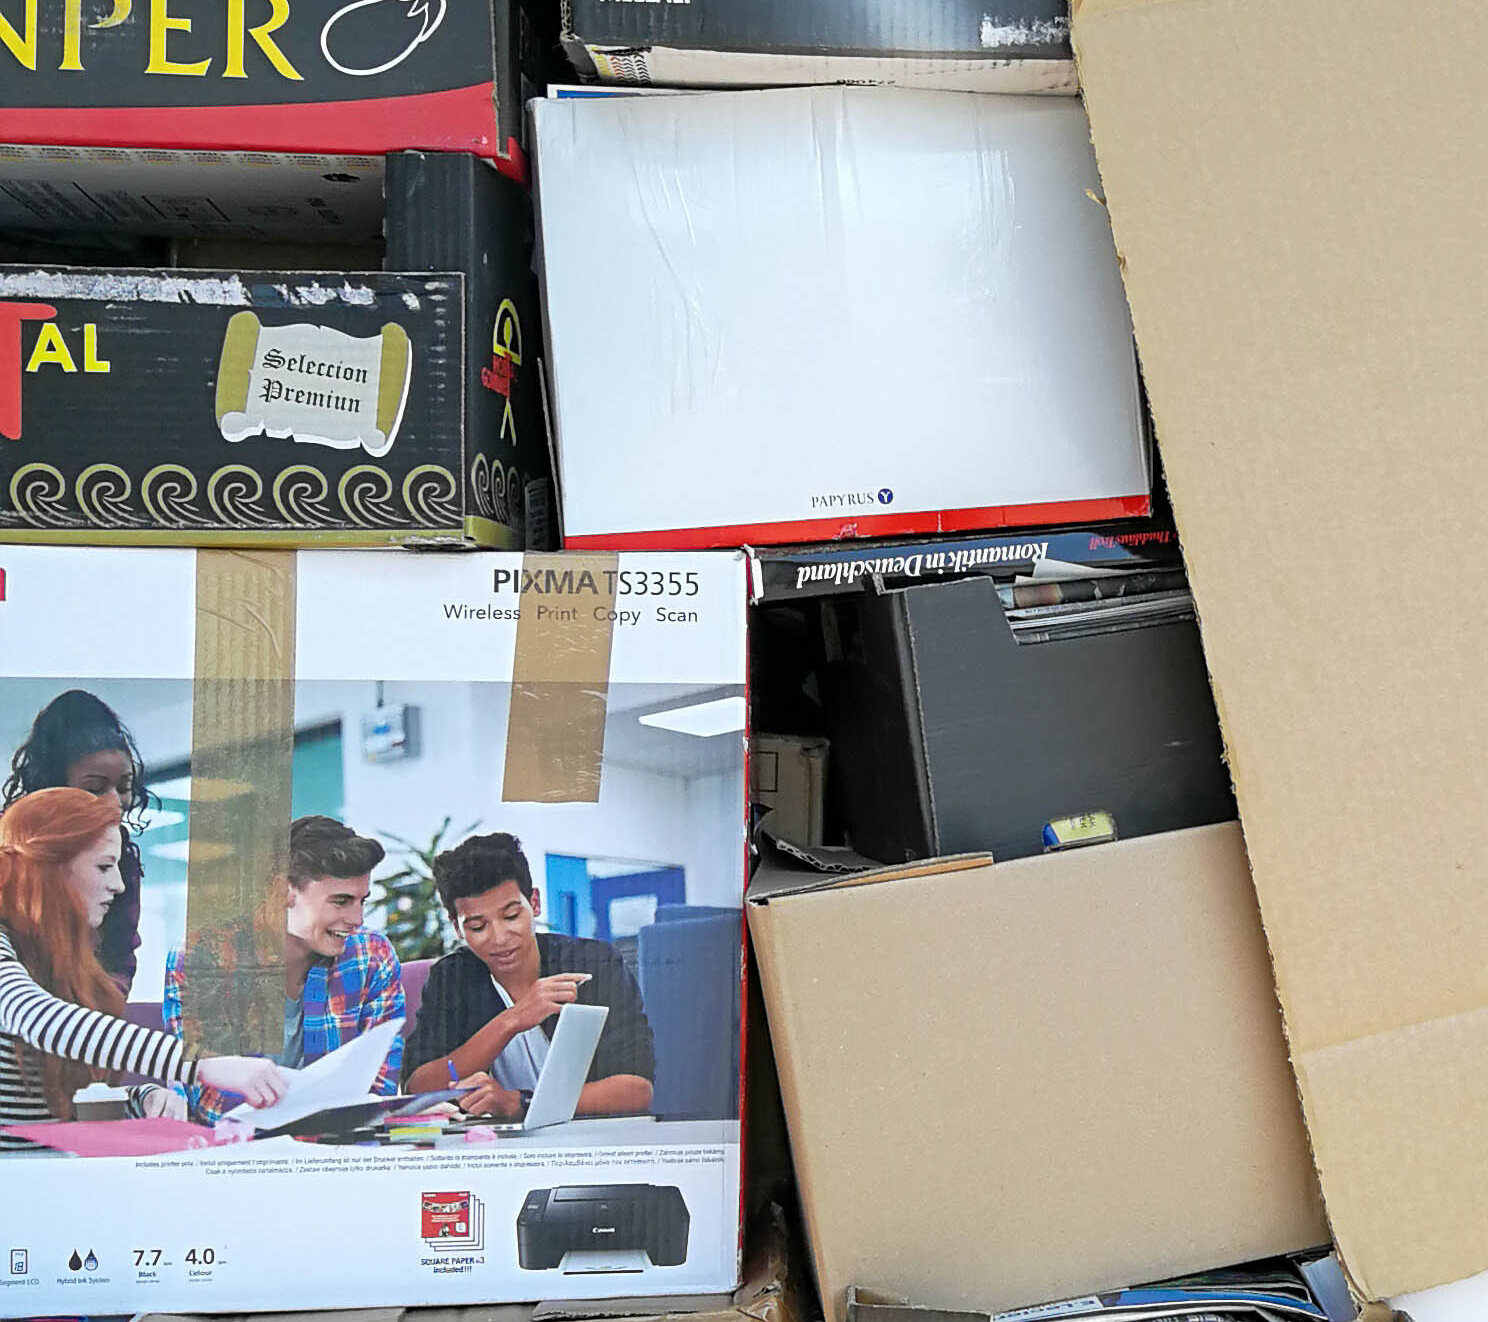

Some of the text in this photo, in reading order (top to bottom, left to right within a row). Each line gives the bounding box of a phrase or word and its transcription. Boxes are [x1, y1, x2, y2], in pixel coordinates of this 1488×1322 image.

[262, 348, 368, 384] Seleccion
[811, 491, 875, 508] PAPYRUS
[925, 552, 946, 574] in
[948, 542, 1048, 572] Romantik
[492, 568, 700, 596] PIXMA TS3355
[443, 603, 698, 626] Wireless Print Copy Scan
[132, 1248, 215, 1266] 7.7 4.0
